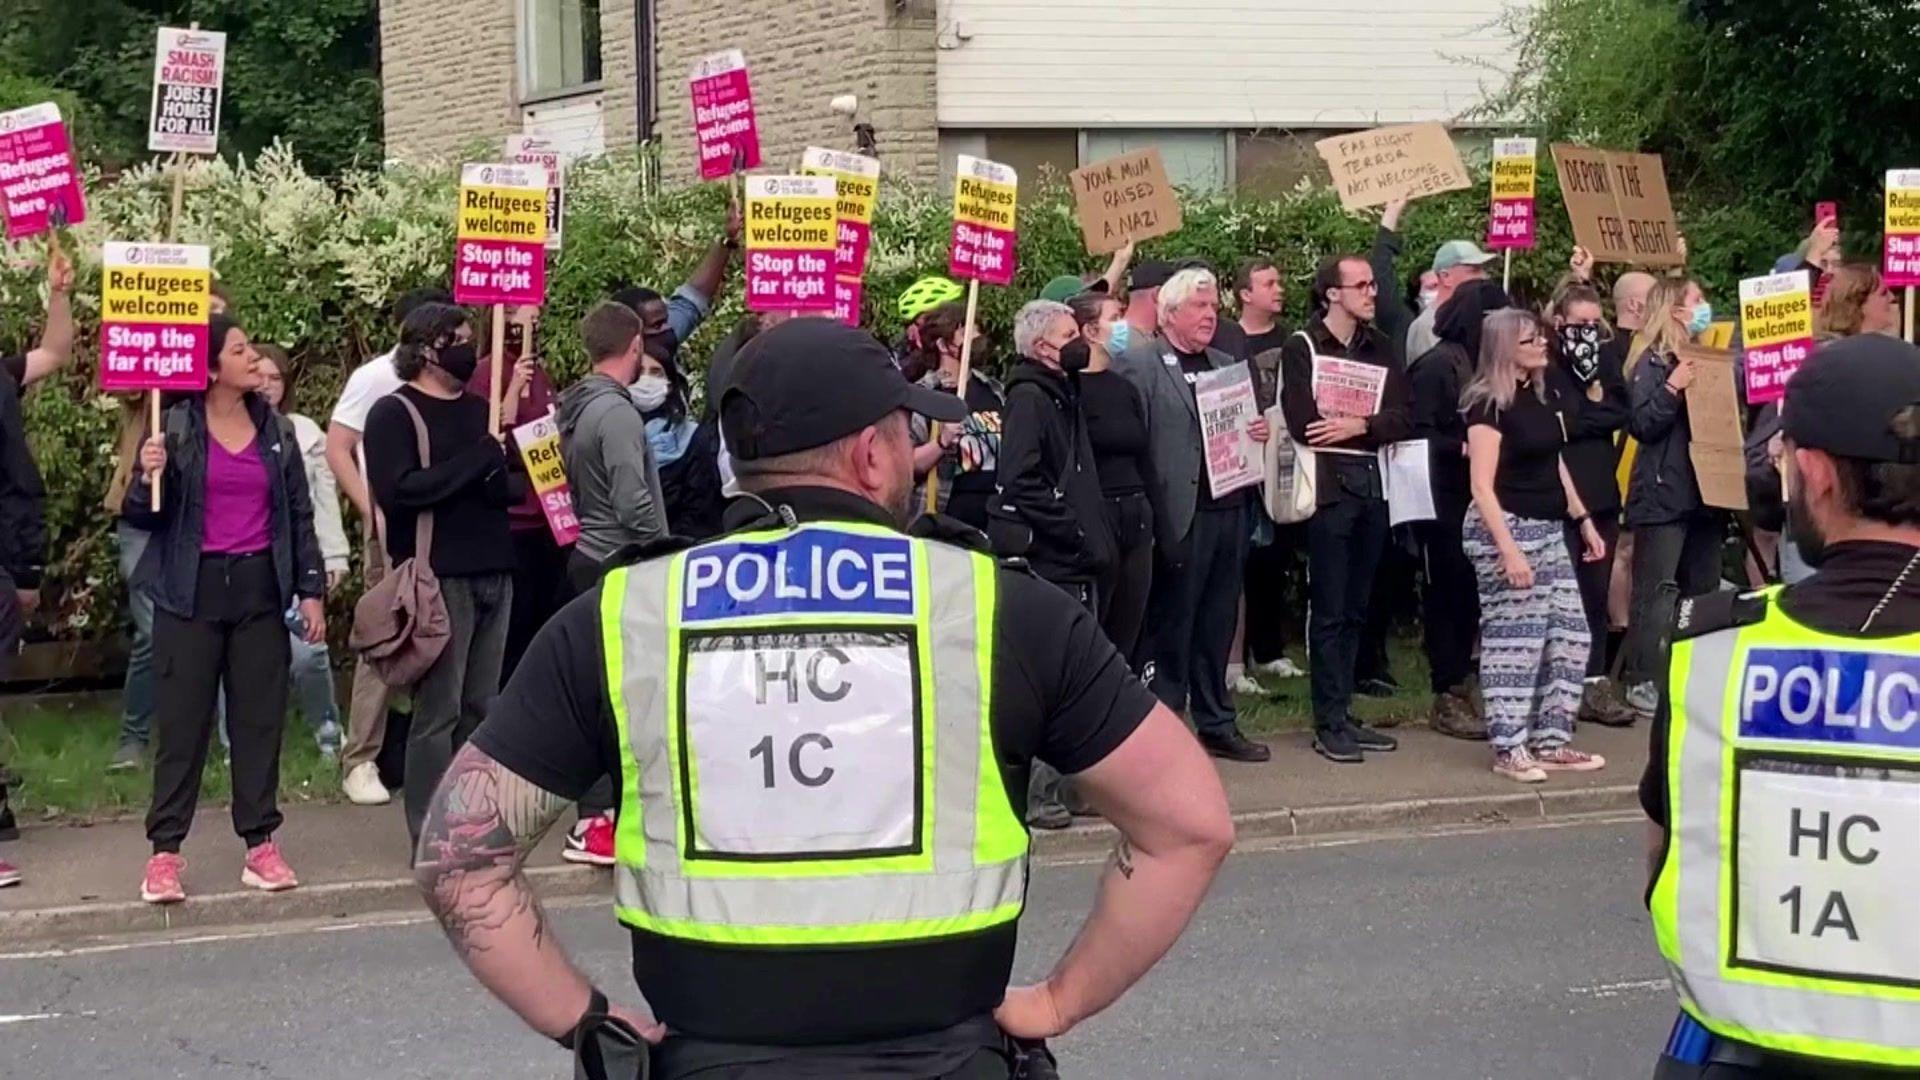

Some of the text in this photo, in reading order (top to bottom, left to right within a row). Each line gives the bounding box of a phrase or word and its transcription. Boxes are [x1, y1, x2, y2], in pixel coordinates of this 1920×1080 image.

[168, 51, 215, 67] SMASH
[161, 67, 217, 85] RACISM!
[163, 85, 213, 103] JOBS &
[163, 101, 211, 118] HOMES
[697, 99, 749, 124] Refugees
[158, 117, 212, 134] FOR ALL
[699, 117, 750, 142] welcome
[702, 141, 731, 160] here
[1339, 132, 1414, 156] FAR RIGHT
[0, 152, 69, 179] Refugees
[1342, 149, 1409, 175] TERROR
[1495, 161, 1532, 178] Refugees
[3, 171, 70, 198] welcome
[1081, 157, 1151, 192] YOUR MUM
[1347, 162, 1439, 196] NOT WELCOME
[1495, 179, 1530, 192] welcome
[1564, 159, 1644, 198] DEPORT THE
[466, 190, 541, 216] Refugees
[960, 179, 1013, 206] Refugees
[1103, 182, 1154, 210] RAISED
[8, 197, 47, 217] here
[752, 202, 832, 224] Refugees
[960, 201, 1009, 224] welcome
[1494, 201, 1528, 220] Stop the
[465, 215, 536, 234] welcome
[752, 224, 828, 242] welcome
[1104, 220, 1114, 239] A
[1493, 219, 1527, 238] far right
[1628, 219, 1671, 254] RIGHT
[956, 224, 1005, 251] Stop the
[1888, 237, 1914, 256] Stop
[462, 243, 533, 269] Stop the
[752, 253, 793, 276] Stop
[797, 254, 826, 272] the
[955, 244, 1002, 271] far right
[1888, 255, 1905, 272] far
[110, 271, 204, 296] Refugees
[460, 266, 531, 292] far right
[752, 275, 825, 298] far right
[835, 284, 852, 301] he
[110, 296, 199, 315] welcome
[1745, 299, 1806, 320] Refugees
[108, 326, 196, 352] Stop the
[1747, 319, 1805, 340] welcome
[108, 350, 193, 376] far right
[1748, 343, 1806, 369] Stop the
[1749, 370, 1771, 388] far
[686, 545, 910, 607] POLICE
[755, 649, 852, 704] HC
[1742, 664, 1919, 733] POLIC
[750, 732, 834, 789] 1C
[1789, 807, 1881, 866] HC
[1779, 885, 1860, 942] 1A
